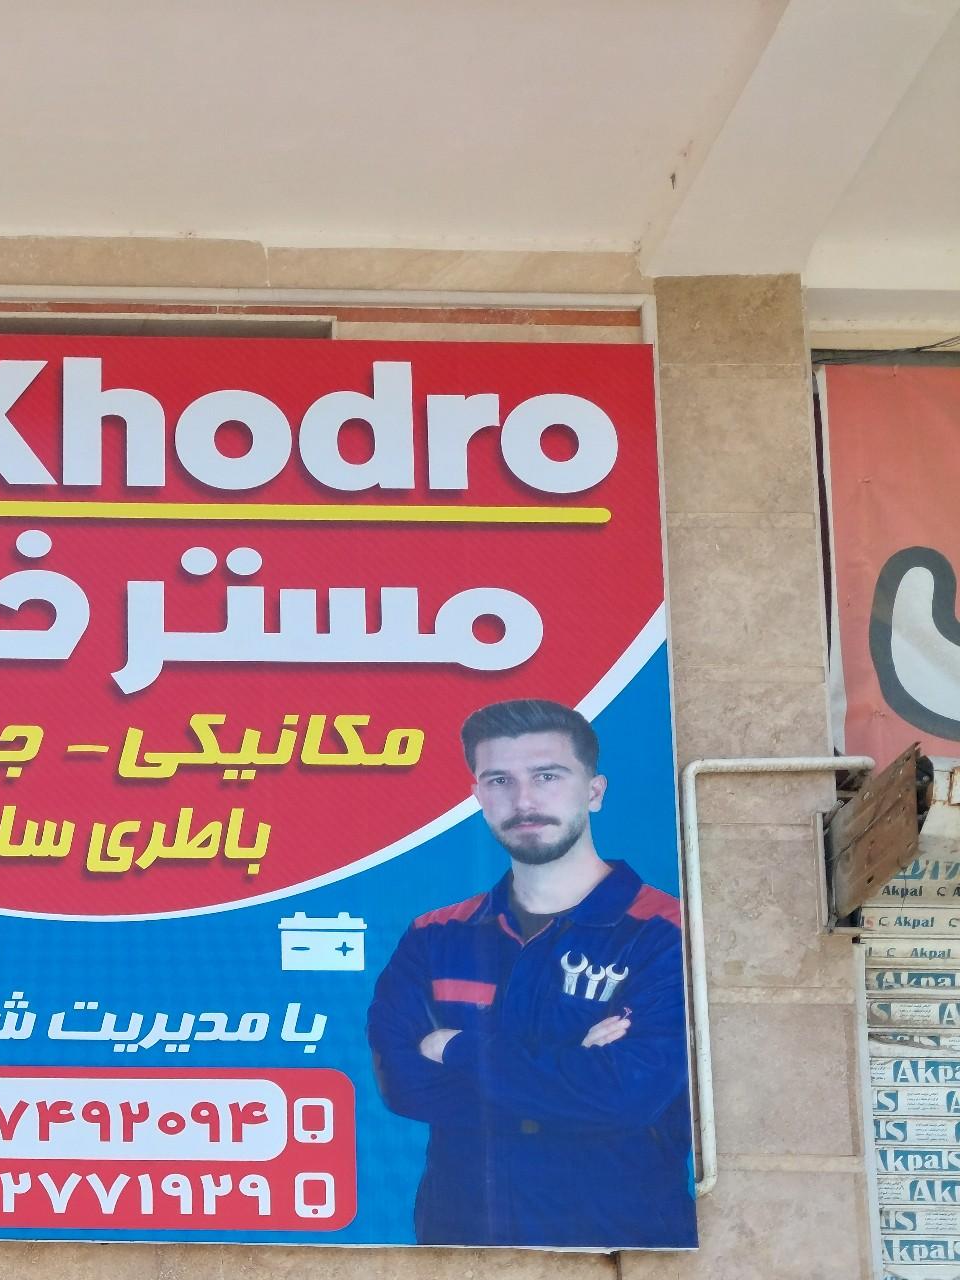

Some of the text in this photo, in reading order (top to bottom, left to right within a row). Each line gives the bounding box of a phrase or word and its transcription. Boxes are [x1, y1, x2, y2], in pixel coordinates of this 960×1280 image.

[110, 546, 544, 695] مستر
[85, 807, 272, 875] باطری
[893, 915, 935, 929] Akpal
[47, 1001, 271, 1053] مدیریت
[280, 1002, 328, 1053] با
